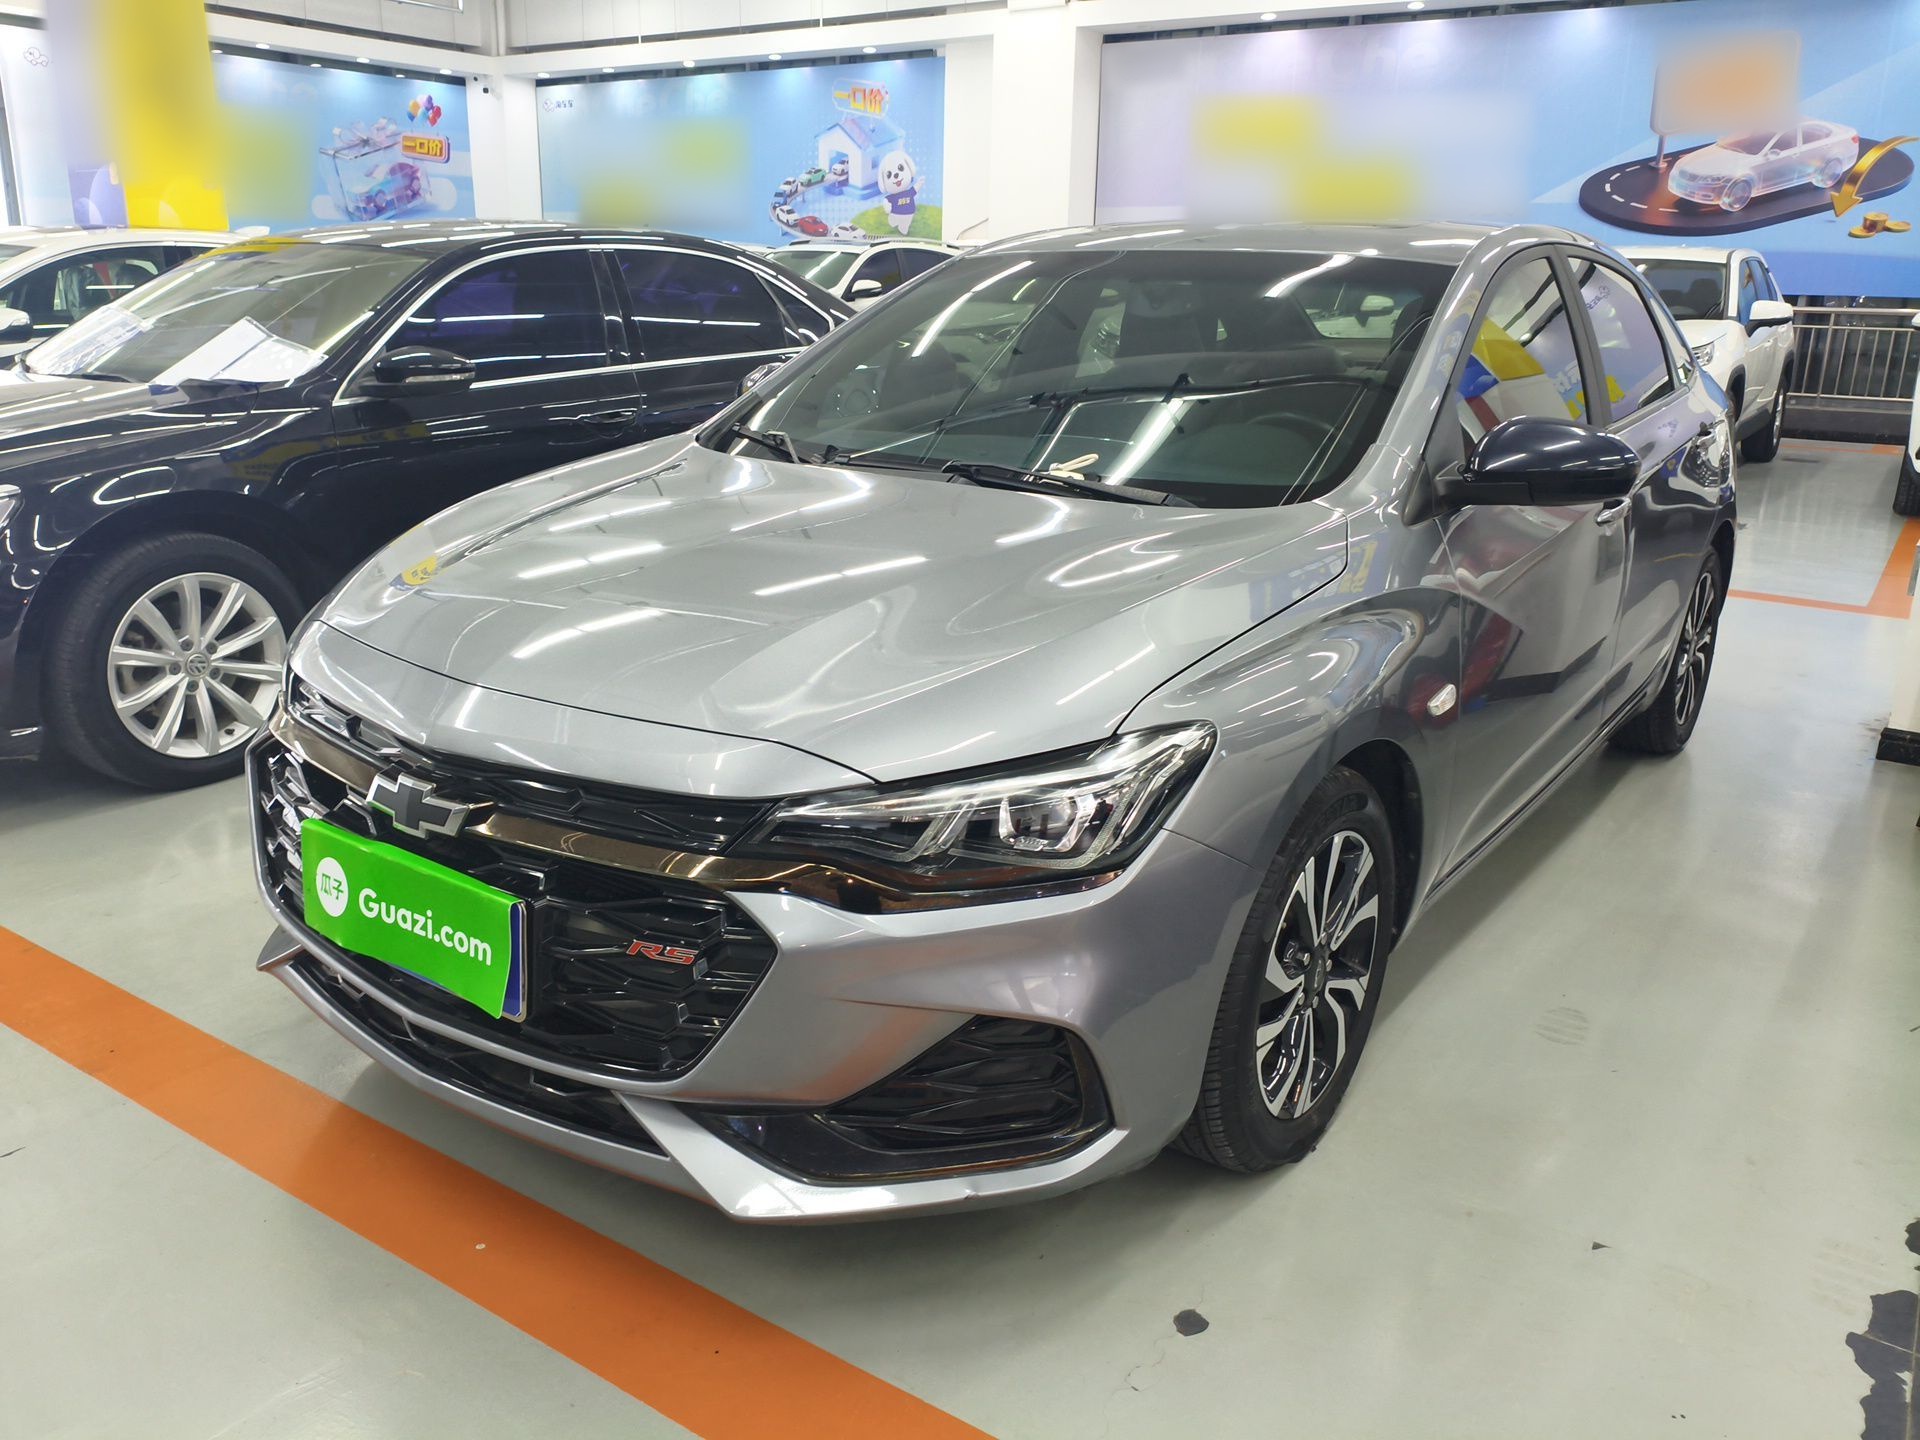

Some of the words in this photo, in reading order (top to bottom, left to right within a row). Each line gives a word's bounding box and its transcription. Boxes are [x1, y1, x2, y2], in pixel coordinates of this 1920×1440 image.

[834, 87, 884, 114] 一口价
[403, 138, 442, 157] 一口价
[320, 872, 344, 900] 瓜子
[359, 887, 492, 966] Guazi.com
[626, 939, 699, 965] RS
